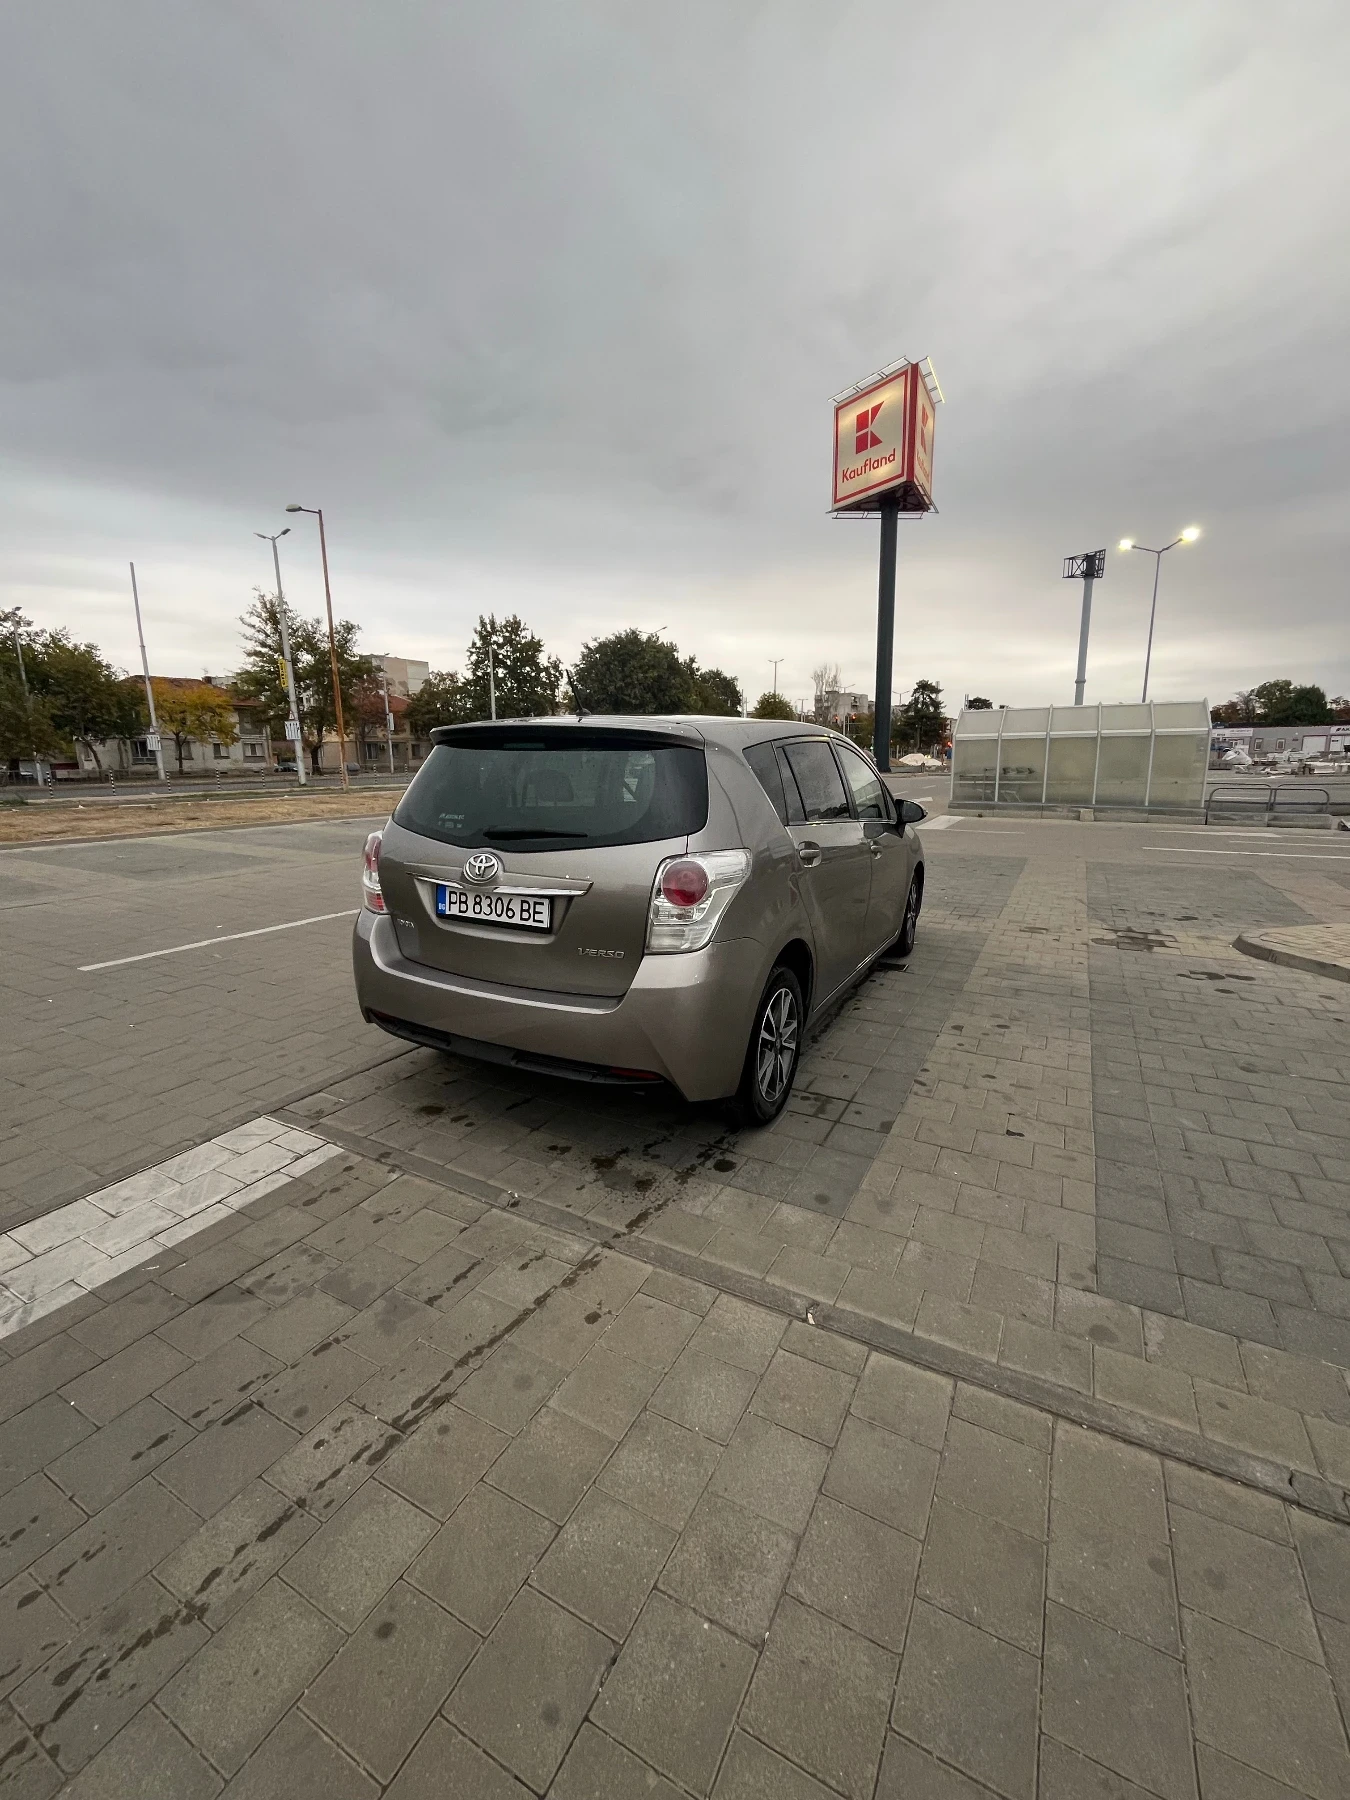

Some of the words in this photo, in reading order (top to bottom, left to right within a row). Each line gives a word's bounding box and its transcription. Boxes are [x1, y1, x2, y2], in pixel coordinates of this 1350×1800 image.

[842, 448, 896, 483] Kaufland
[448, 891, 469, 914] PB
[472, 894, 516, 919] 8306
[520, 899, 545, 924] BE
[577, 947, 625, 959] VERSO
